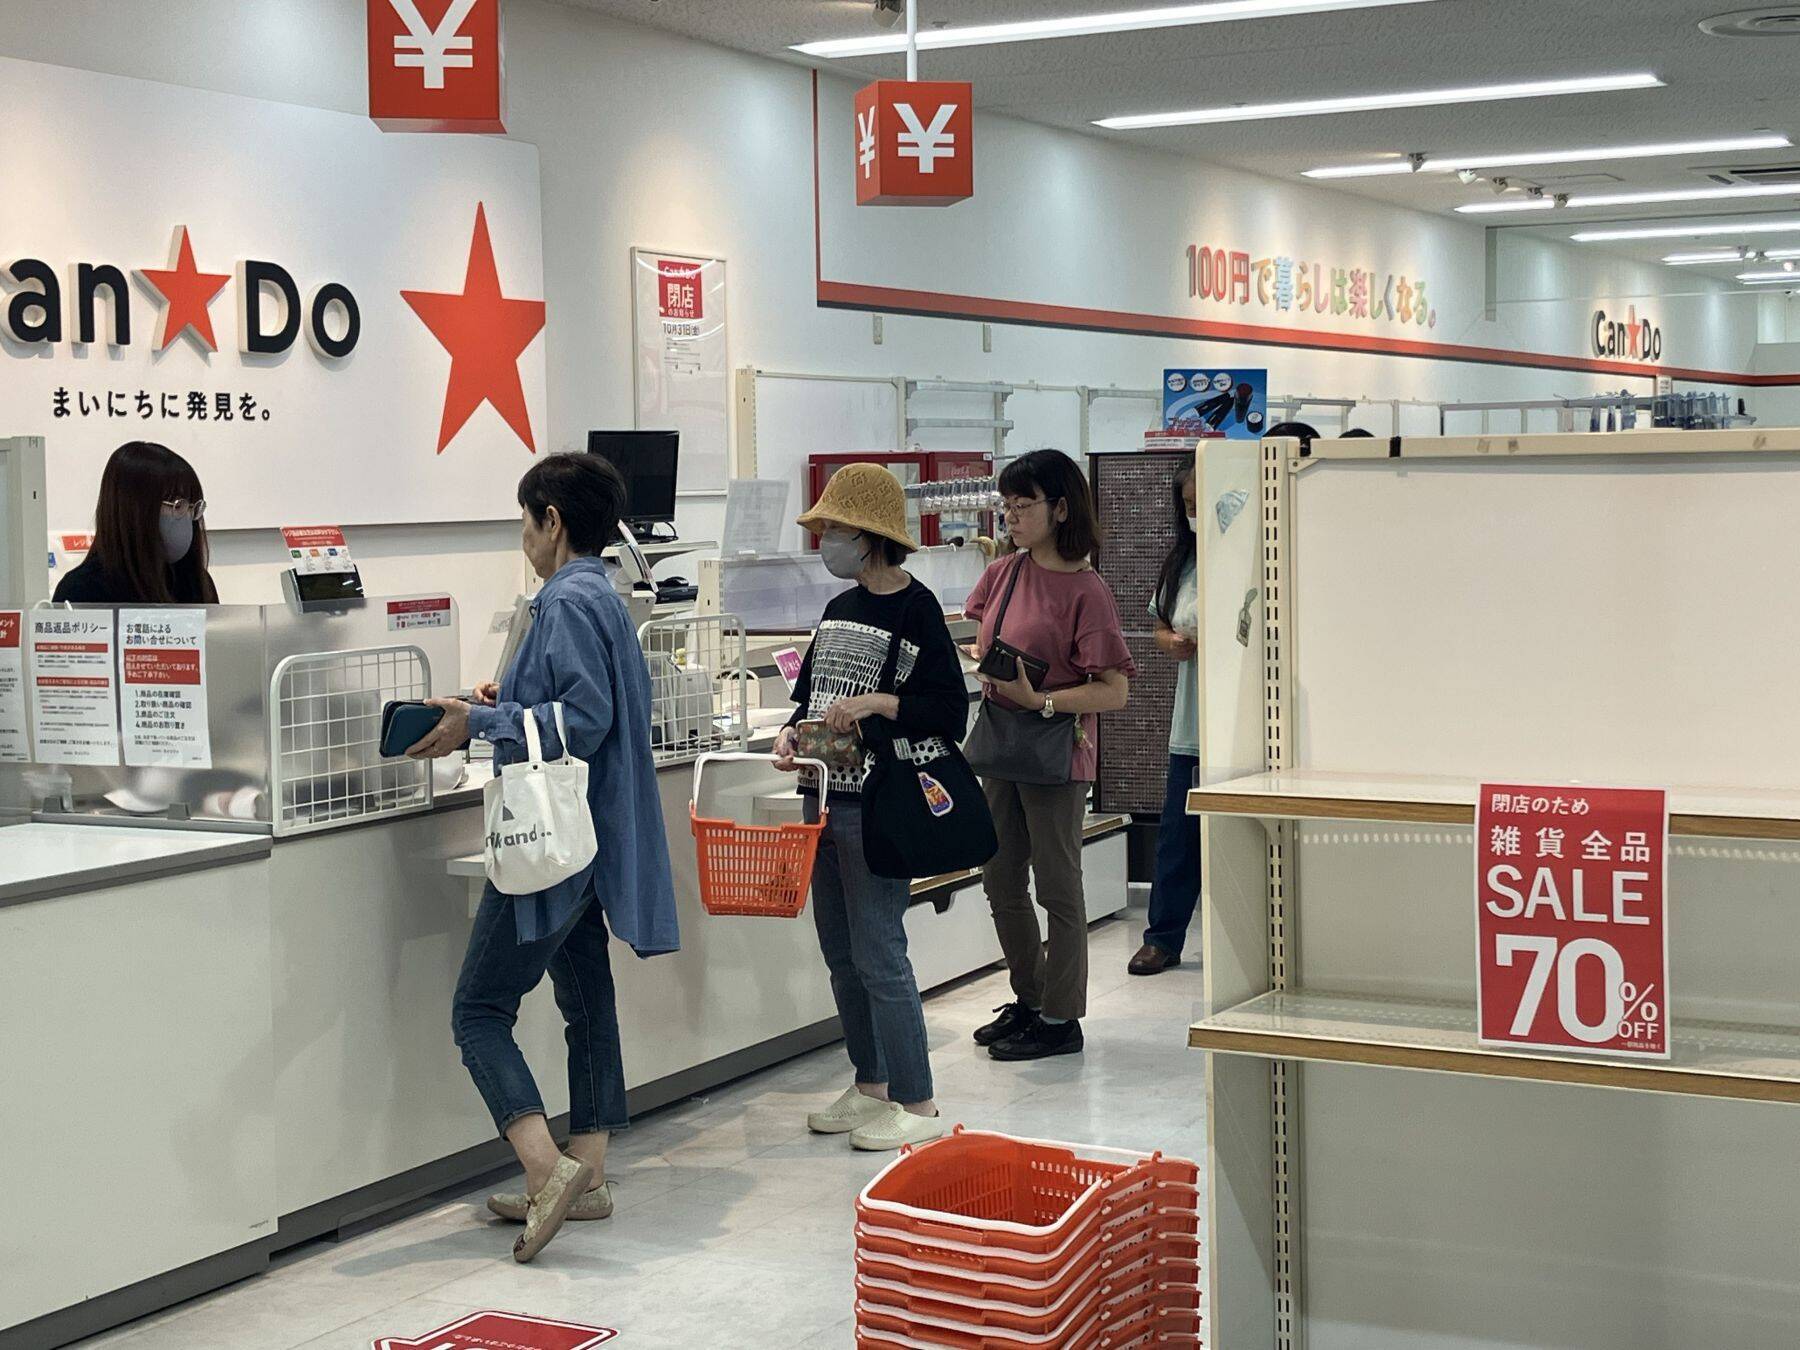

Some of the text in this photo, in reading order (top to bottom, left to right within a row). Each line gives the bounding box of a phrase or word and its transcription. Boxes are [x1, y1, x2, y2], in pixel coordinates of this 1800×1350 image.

[667, 283, 694, 309] 閉店
[1186, 244, 1436, 328] 100円で暮らしは楽しくなる。
[237, 260, 361, 358] Do
[1592, 310, 1662, 361] Can Do
[53, 386, 271, 422] まいにちに発見を。
[35, 621, 108, 634] 商品返品ポリシー
[126, 623, 172, 634] お電話による
[126, 635, 197, 646] お問い合せについて
[1491, 793, 1590, 816] 閉店のため
[1486, 864, 1650, 926] SALE
[1618, 1021, 1660, 1040] OFF
